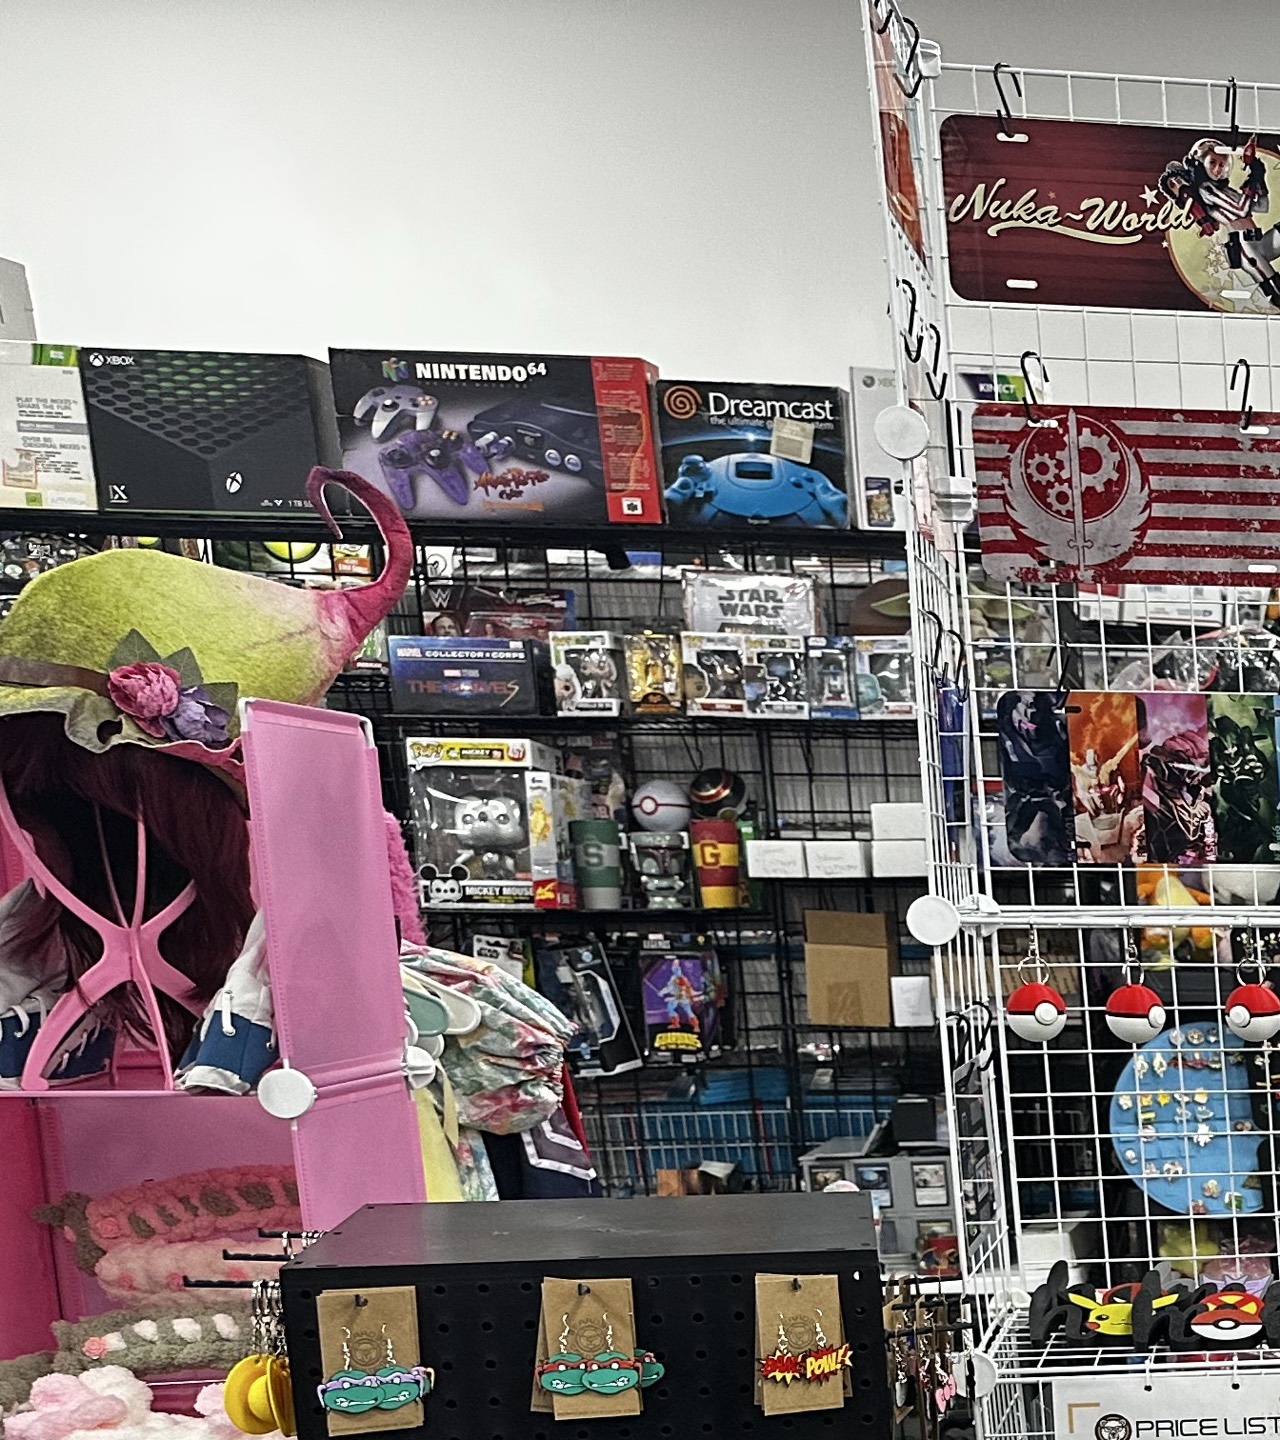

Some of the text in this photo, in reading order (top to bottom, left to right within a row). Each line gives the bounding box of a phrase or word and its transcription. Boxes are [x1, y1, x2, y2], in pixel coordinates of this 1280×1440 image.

[105, 355, 135, 366] XBOX
[415, 362, 547, 382] NINTENDO 64
[709, 392, 833, 420] Dreamcast
[719, 603, 784, 618] WARS
[701, 841, 721, 869] G
[1136, 1417, 1219, 1439] PRICE
